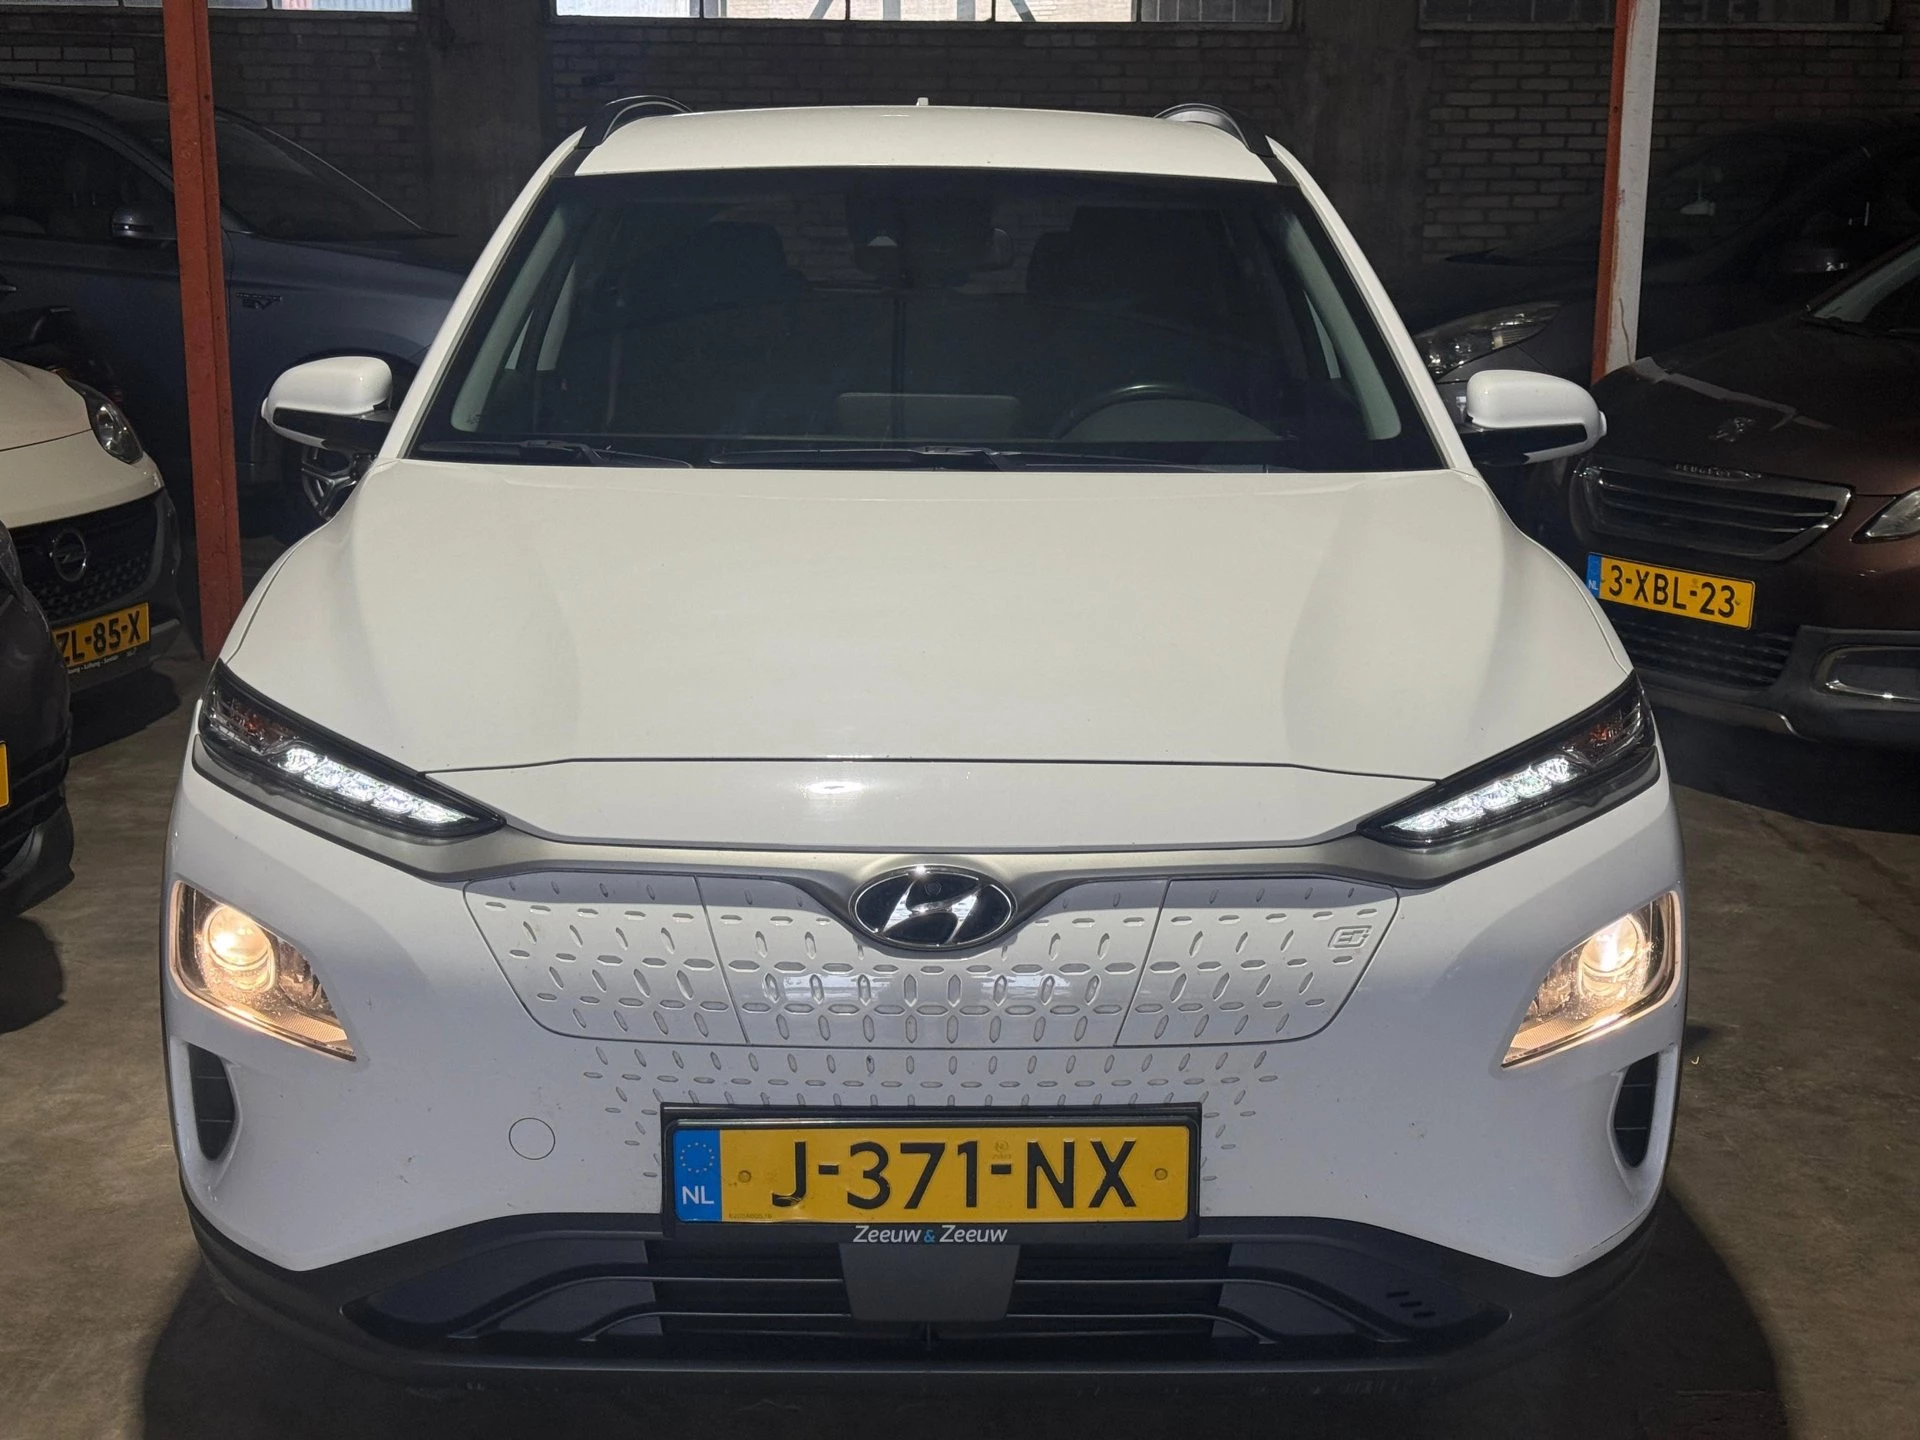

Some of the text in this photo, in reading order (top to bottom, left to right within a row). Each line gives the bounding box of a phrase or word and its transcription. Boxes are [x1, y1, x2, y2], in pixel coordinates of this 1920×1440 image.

[1588, 579, 1599, 591] NL
[1609, 565, 1736, 618] 3-XBL-23
[771, 1141, 1137, 1210] J-371-NX
[682, 1185, 714, 1206] NL
[853, 1225, 1008, 1243] Zeeuw & Zeeuw
